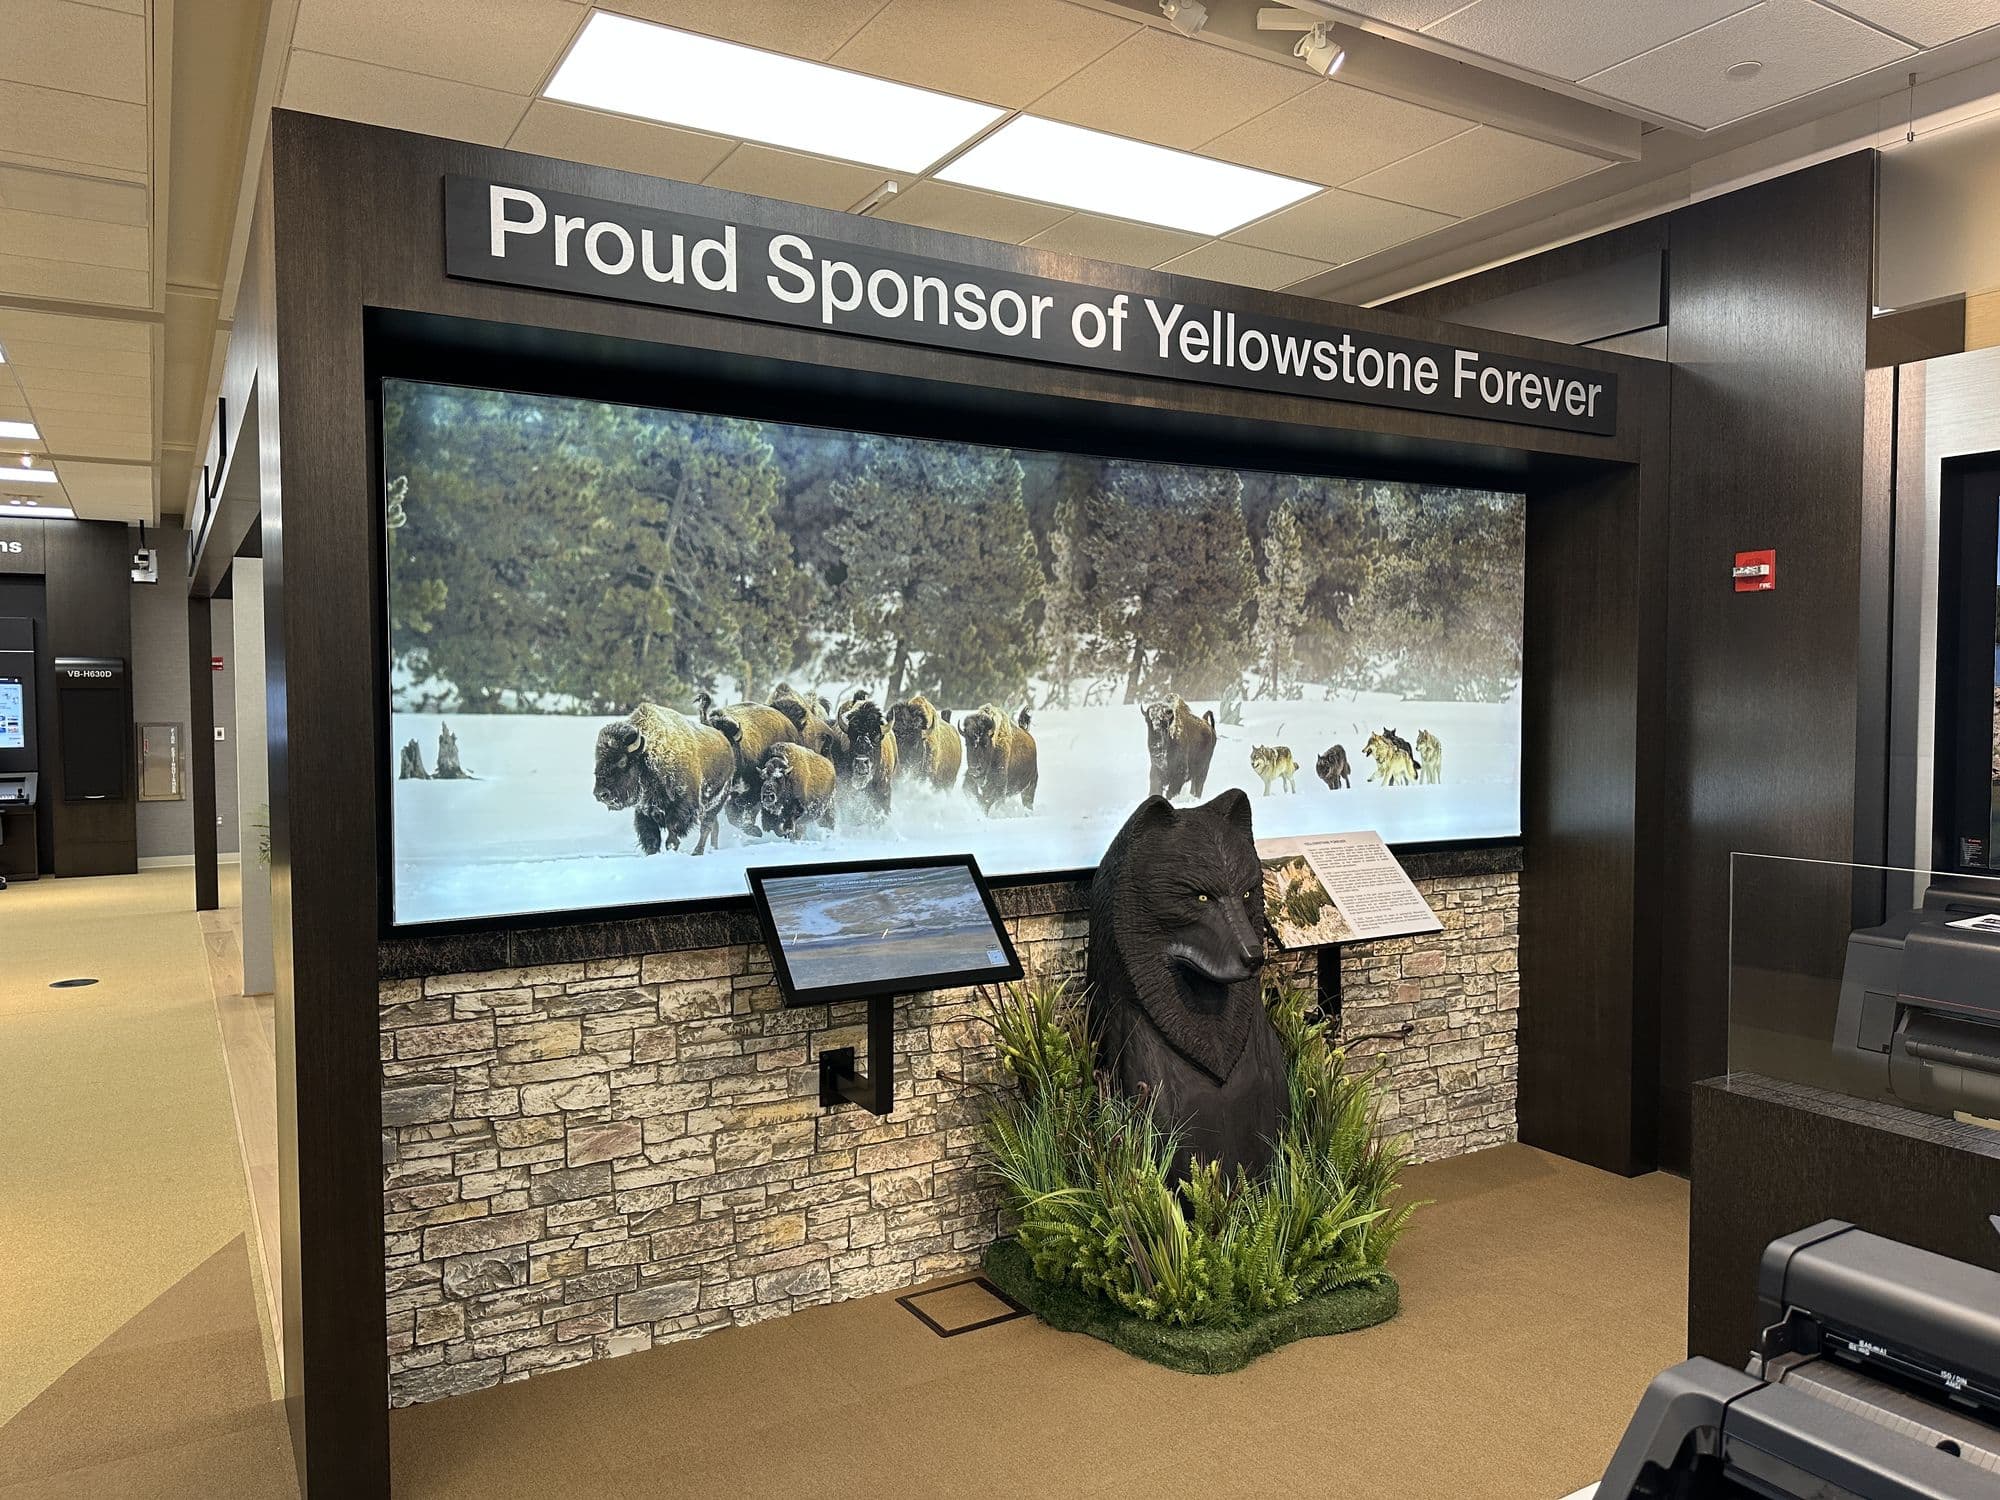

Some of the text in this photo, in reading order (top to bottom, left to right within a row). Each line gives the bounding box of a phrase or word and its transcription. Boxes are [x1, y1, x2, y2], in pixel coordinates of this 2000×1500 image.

[488, 184, 1602, 418] Proud Sponsor of Yellowstone Forever
[67, 670, 112, 679] VB-H630D
